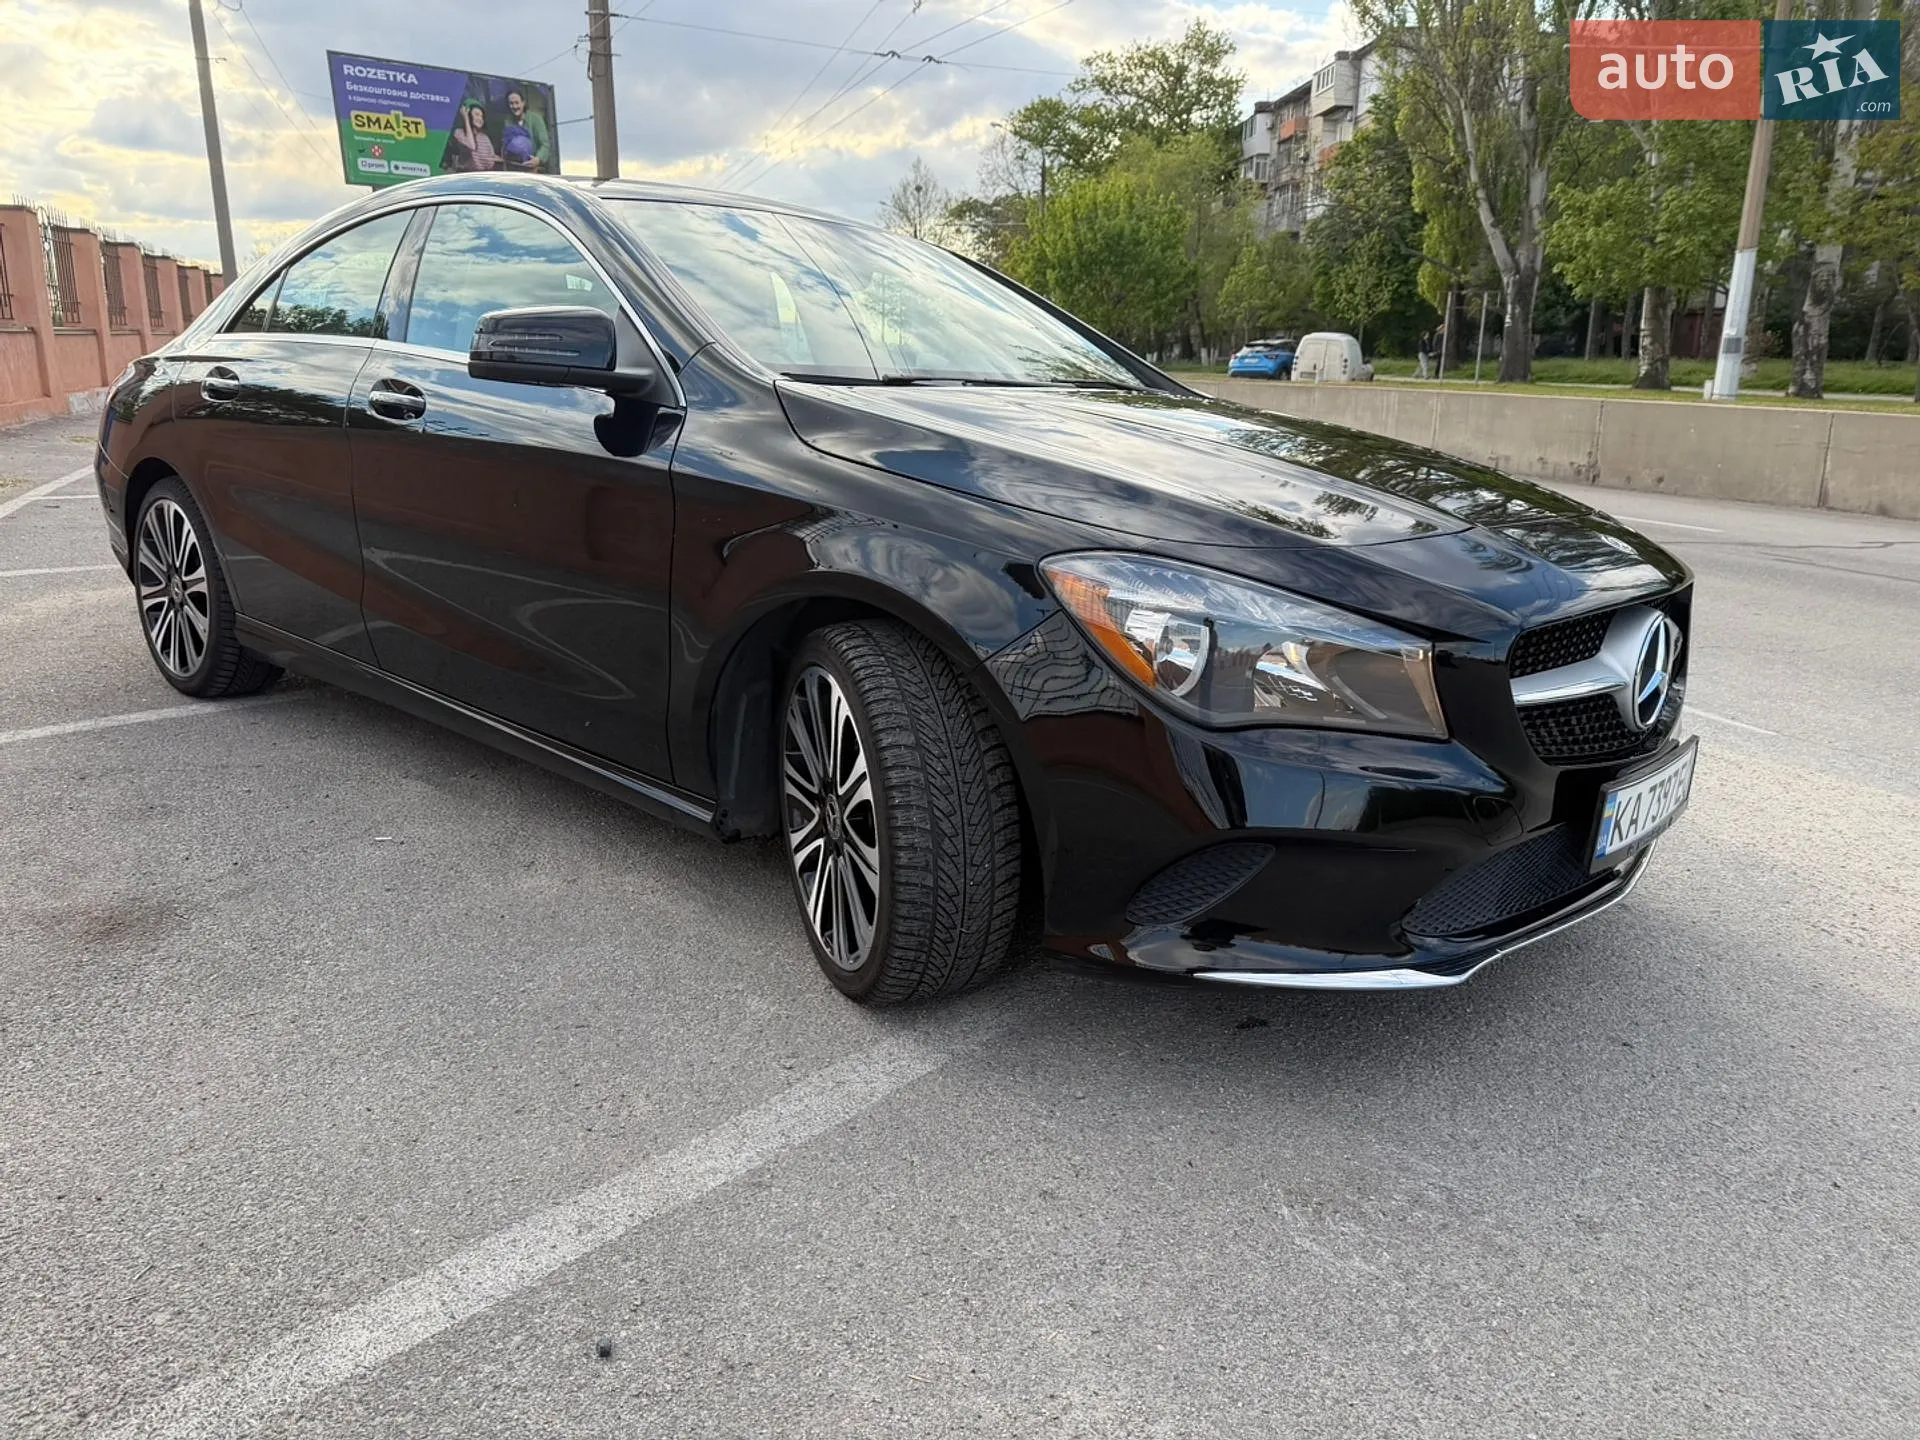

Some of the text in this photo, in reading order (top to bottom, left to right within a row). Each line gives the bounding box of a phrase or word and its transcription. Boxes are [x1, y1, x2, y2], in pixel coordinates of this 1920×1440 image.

[343, 64, 418, 85] ROZETKA
[346, 81, 450, 103] Безкоштовна доставка
